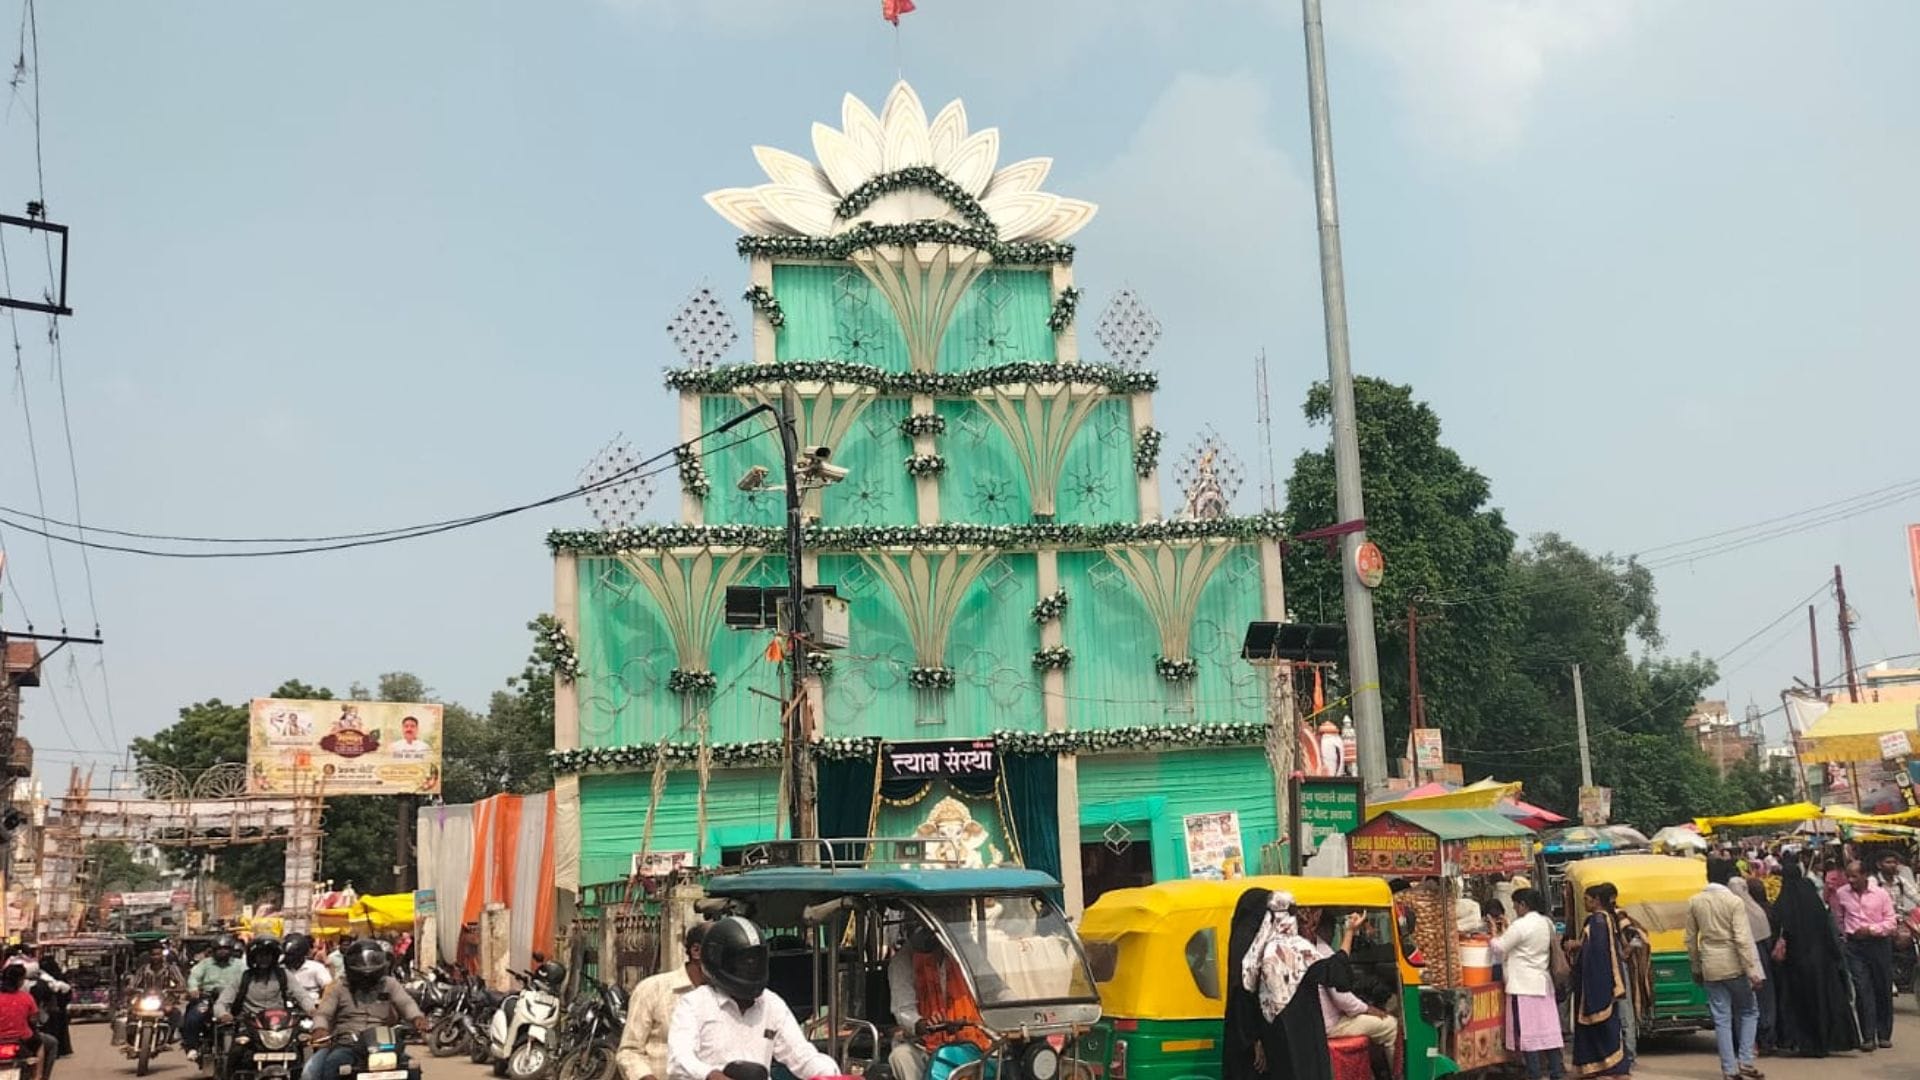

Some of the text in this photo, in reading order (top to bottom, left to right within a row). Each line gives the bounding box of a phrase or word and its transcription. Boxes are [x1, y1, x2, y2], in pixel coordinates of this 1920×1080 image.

[890, 747, 993, 775] त्याग संस्था
[1407, 837, 1437, 851] CENTER
